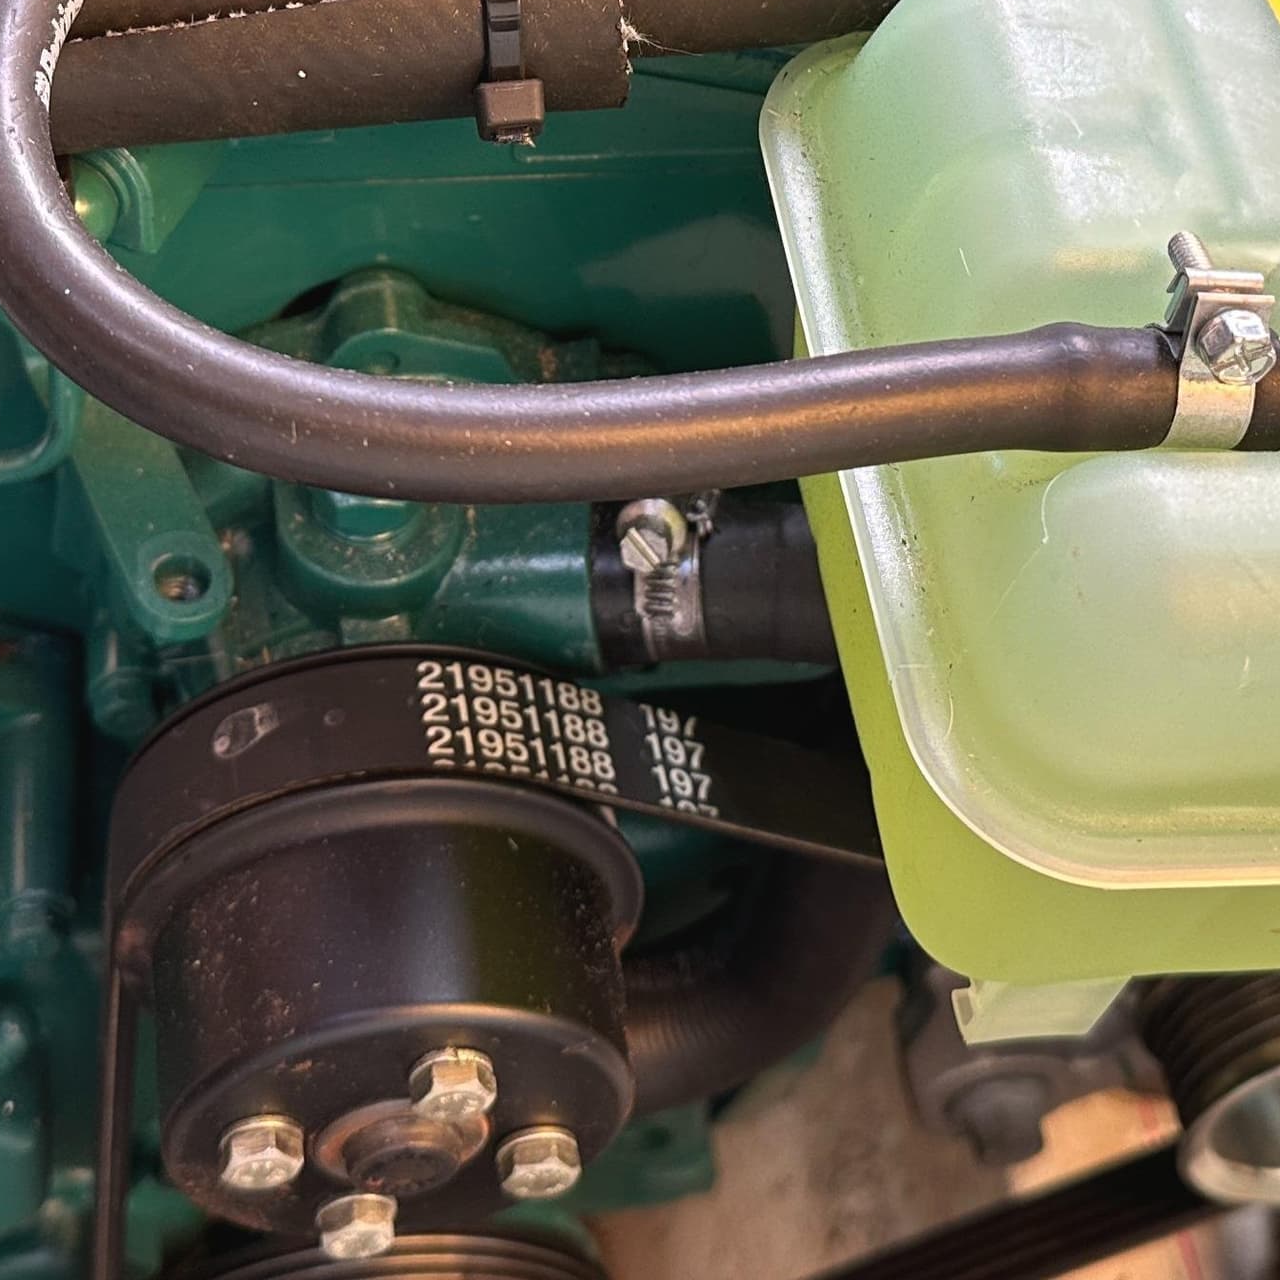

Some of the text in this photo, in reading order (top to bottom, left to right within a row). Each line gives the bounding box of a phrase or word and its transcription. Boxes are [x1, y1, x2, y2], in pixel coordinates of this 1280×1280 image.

[416, 660, 604, 717] 21951188
[421, 693, 705, 770] 21951188 197
[426, 725, 617, 781] 21951188
[651, 764, 713, 801] 197
